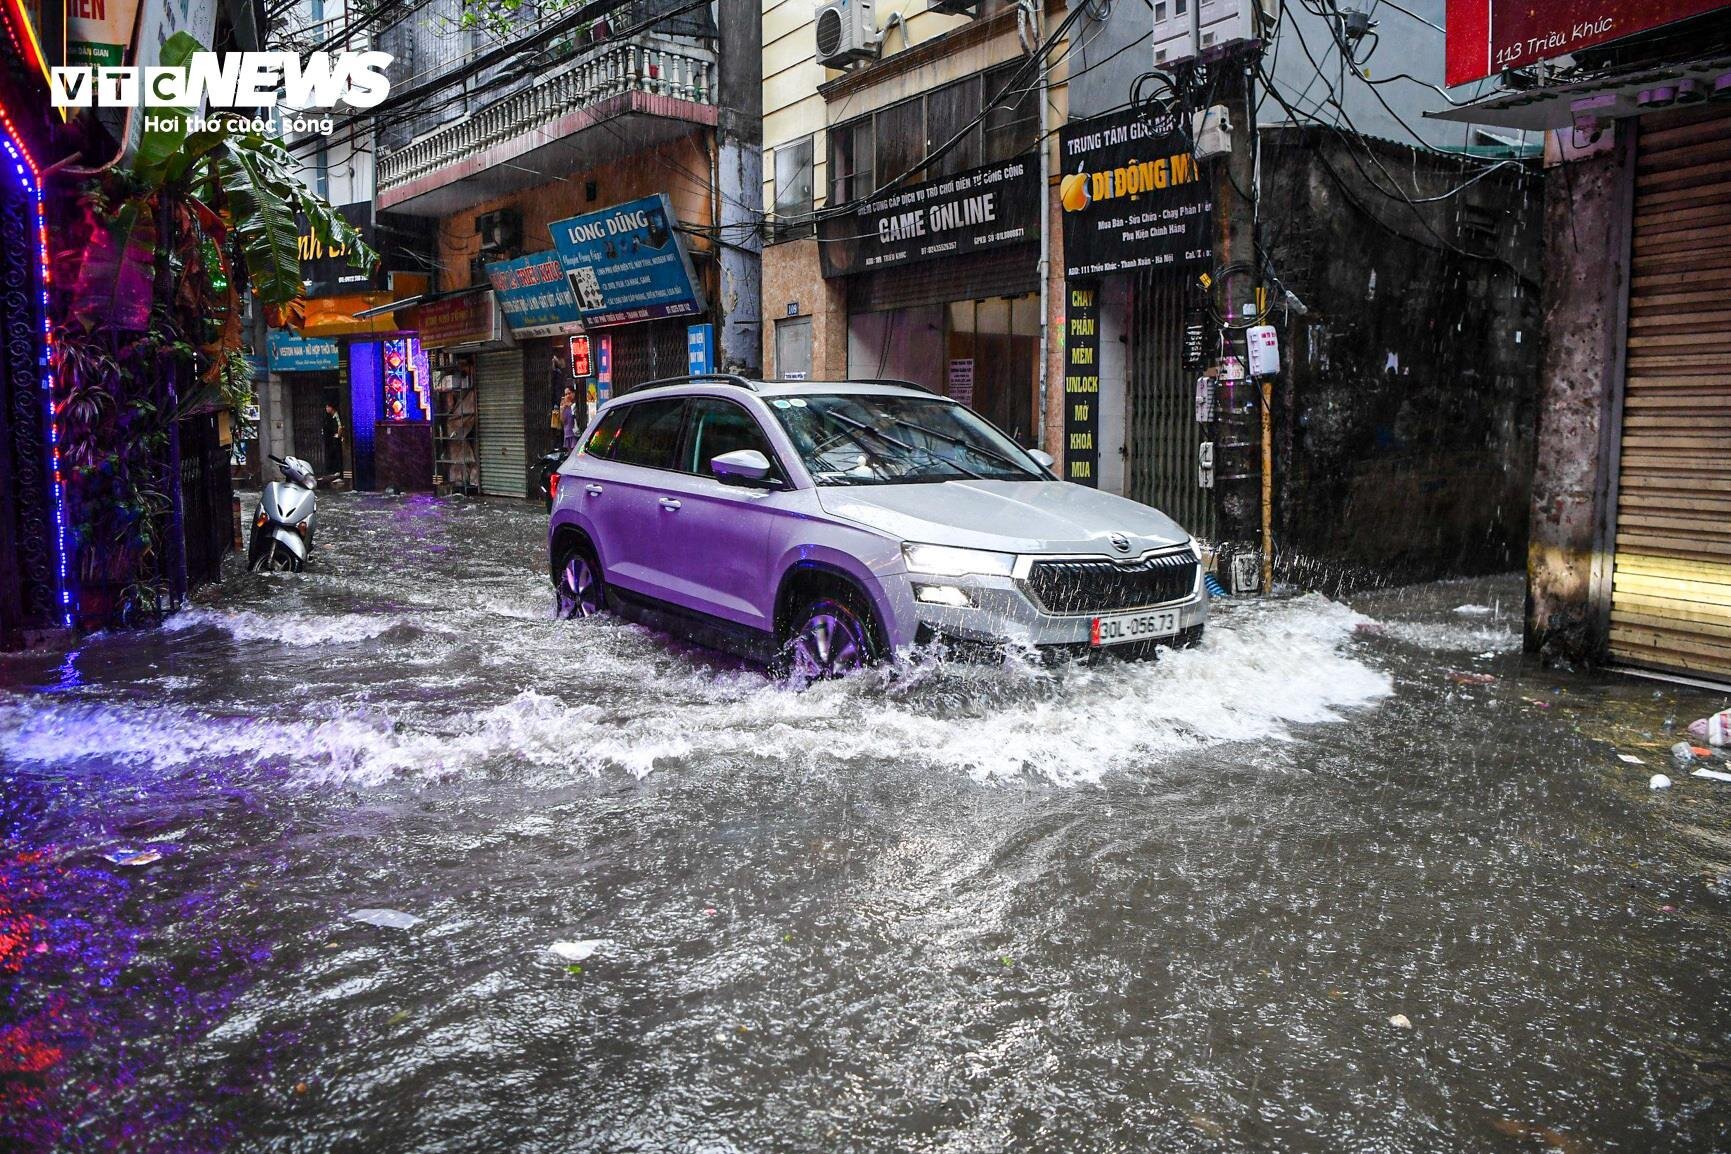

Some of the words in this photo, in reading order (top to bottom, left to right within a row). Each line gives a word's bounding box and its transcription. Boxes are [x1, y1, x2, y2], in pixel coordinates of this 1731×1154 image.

[1496, 42, 1522, 65] 113
[1527, 31, 1566, 55] Triều
[1571, 16, 1613, 42] Khúc
[92, 49, 109, 58] GIAN
[1067, 132, 1101, 155] TRUNG
[1103, 125, 1128, 147] TÂM
[872, 199, 889, 213] CUNG
[888, 193, 901, 208] CẤP
[901, 192, 916, 207] DỊCH
[916, 189, 925, 203] VỤ
[926, 183, 938, 199] TRÒ
[939, 179, 954, 195] CHƠI
[1003, 163, 1024, 181] CỘNG
[1114, 158, 1168, 201] ĐỘNG
[567, 221, 606, 245] LONG
[605, 209, 650, 236] DŨNG
[878, 209, 926, 244] GAME
[929, 192, 996, 233] ONLINE
[1097, 220, 1111, 230] Mua
[1112, 217, 1124, 228] Bán
[1162, 209, 1179, 220] Chạy
[1122, 231, 1135, 242] Phụ
[1150, 225, 1168, 237] Chính
[1081, 265, 1090, 274] 111
[1104, 261, 1117, 271] Khúc
[1120, 259, 1137, 269] Thanh
[1137, 256, 1152, 267] Xuân
[1155, 255, 1163, 264] Hà
[788, 303, 798, 315] 109
[1072, 290, 1093, 310] CHẠY
[1071, 313, 1095, 336] PHẦN
[1071, 341, 1093, 364] MỀM
[1066, 376, 1098, 393] UNLOCK
[1074, 401, 1090, 422] MỞ
[1070, 431, 1093, 450] KHOÁ
[1071, 461, 1091, 478] MUA
